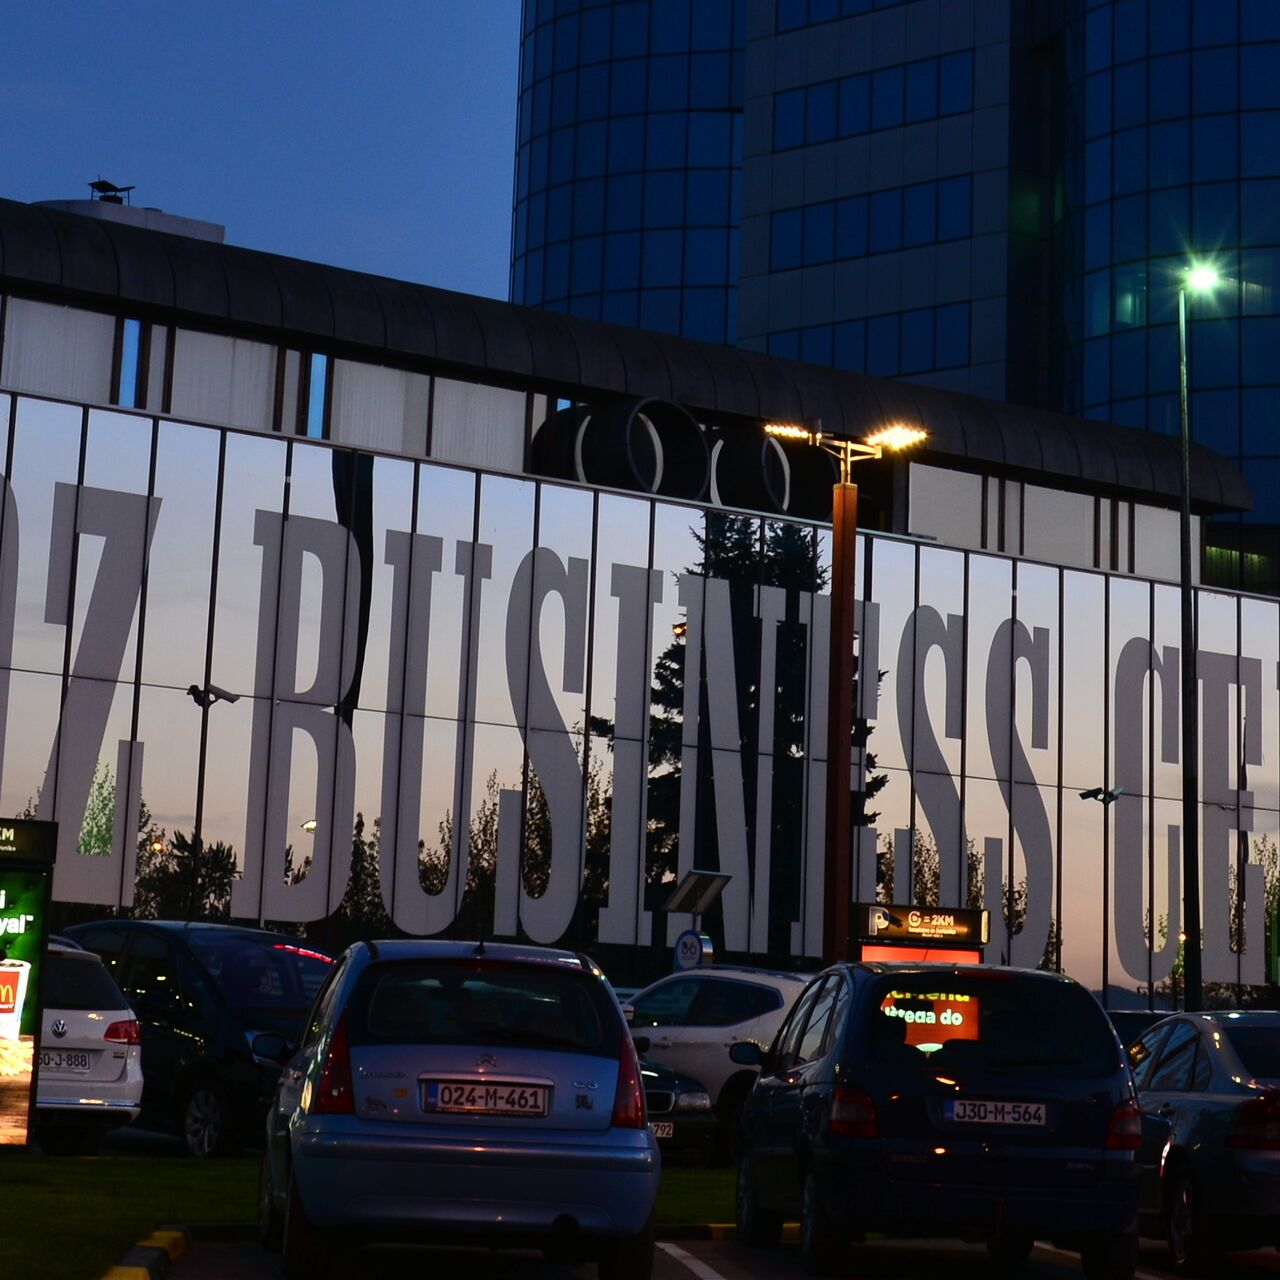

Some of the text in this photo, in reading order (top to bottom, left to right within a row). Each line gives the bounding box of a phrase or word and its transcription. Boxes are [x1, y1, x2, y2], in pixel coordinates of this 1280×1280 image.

[232, 509, 1053, 971] BUSINESS
[931, 914, 954, 927] 2KM
[940, 1009, 963, 1025] do
[955, 1102, 1042, 1123] J30-M-564
